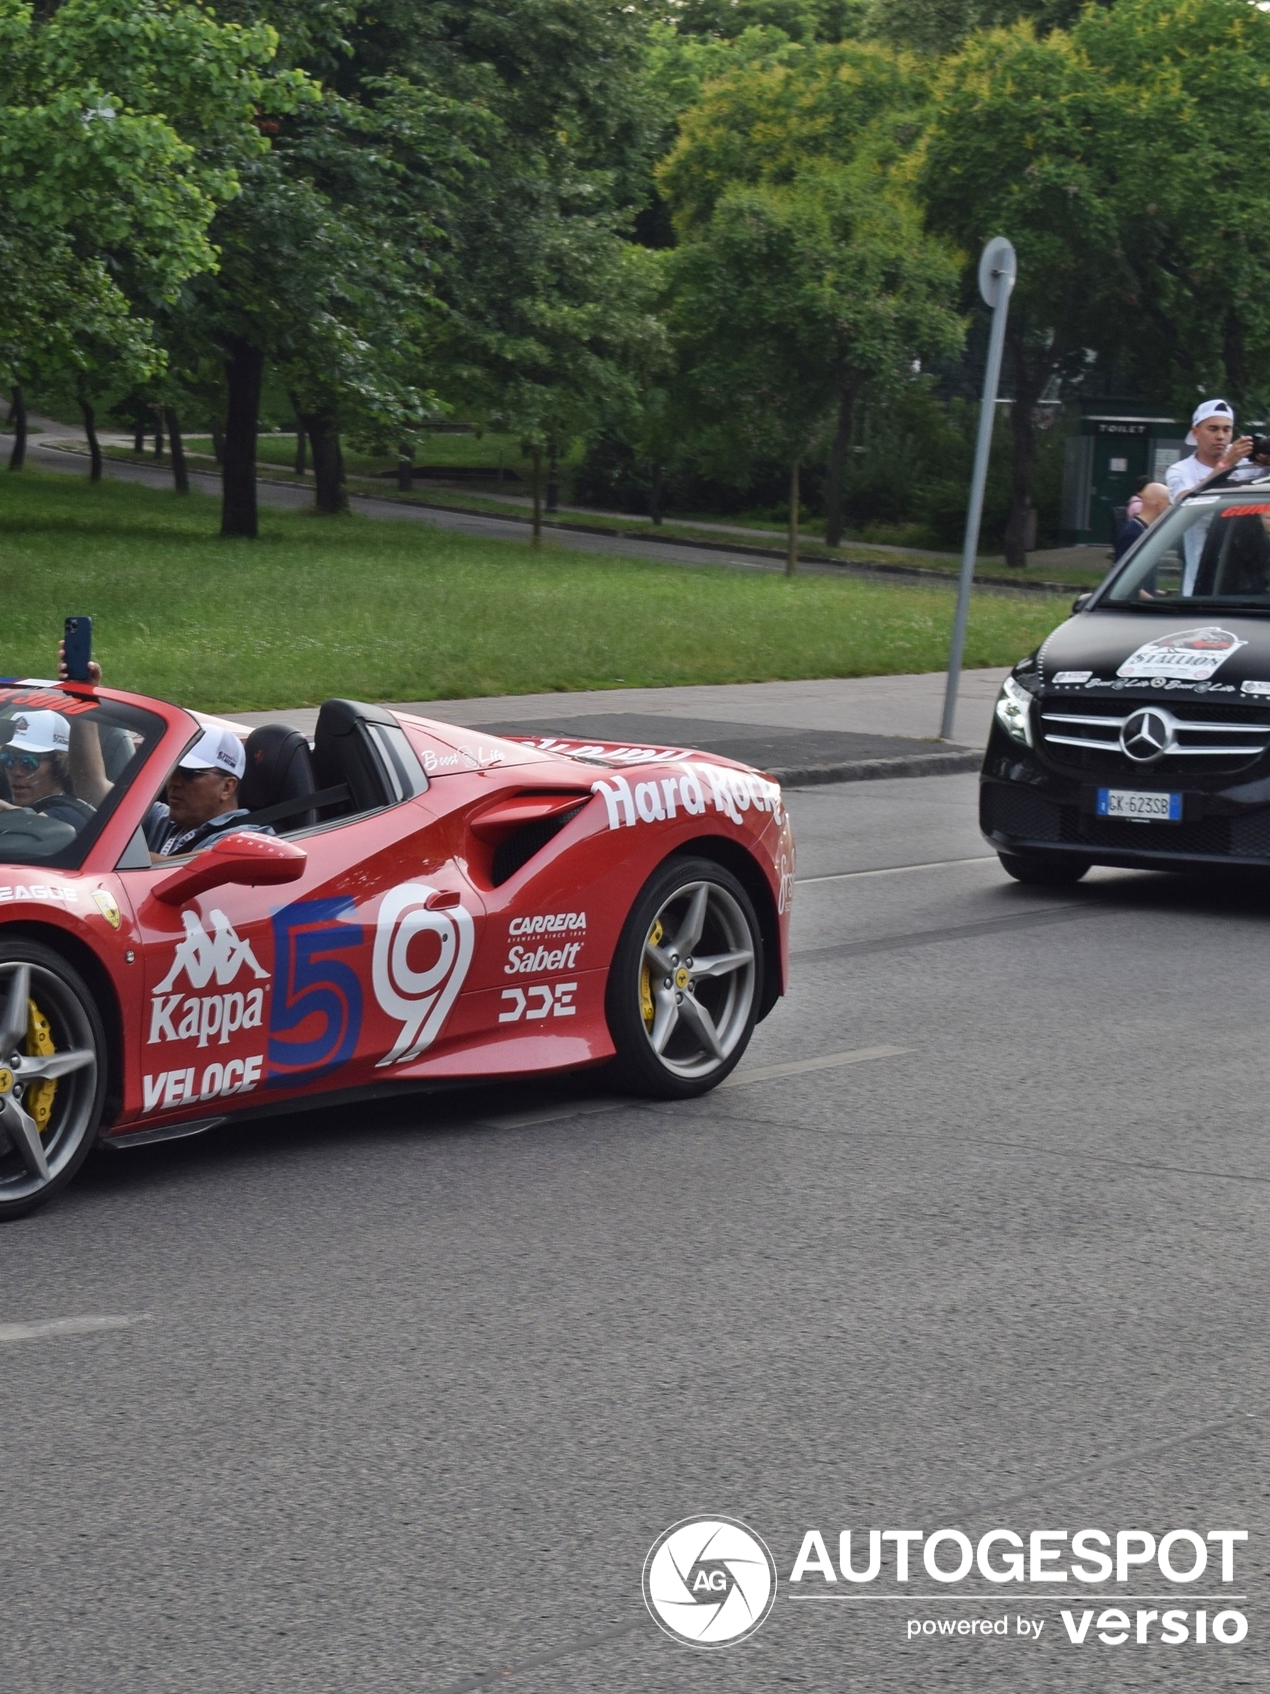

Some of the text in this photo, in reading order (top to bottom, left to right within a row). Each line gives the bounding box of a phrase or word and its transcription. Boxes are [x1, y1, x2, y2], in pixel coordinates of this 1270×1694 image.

[1098, 423, 1146, 434] TOILET
[12, 692, 101, 715] 3000
[478, 747, 506, 763] Life
[591, 762, 781, 830] Hard Rock
[509, 912, 587, 935] CARRERA
[504, 942, 581, 974] Sabelt
[147, 987, 263, 1048] Kappa
[498, 982, 578, 1023] DDE
[143, 1055, 263, 1113] VELOCE
